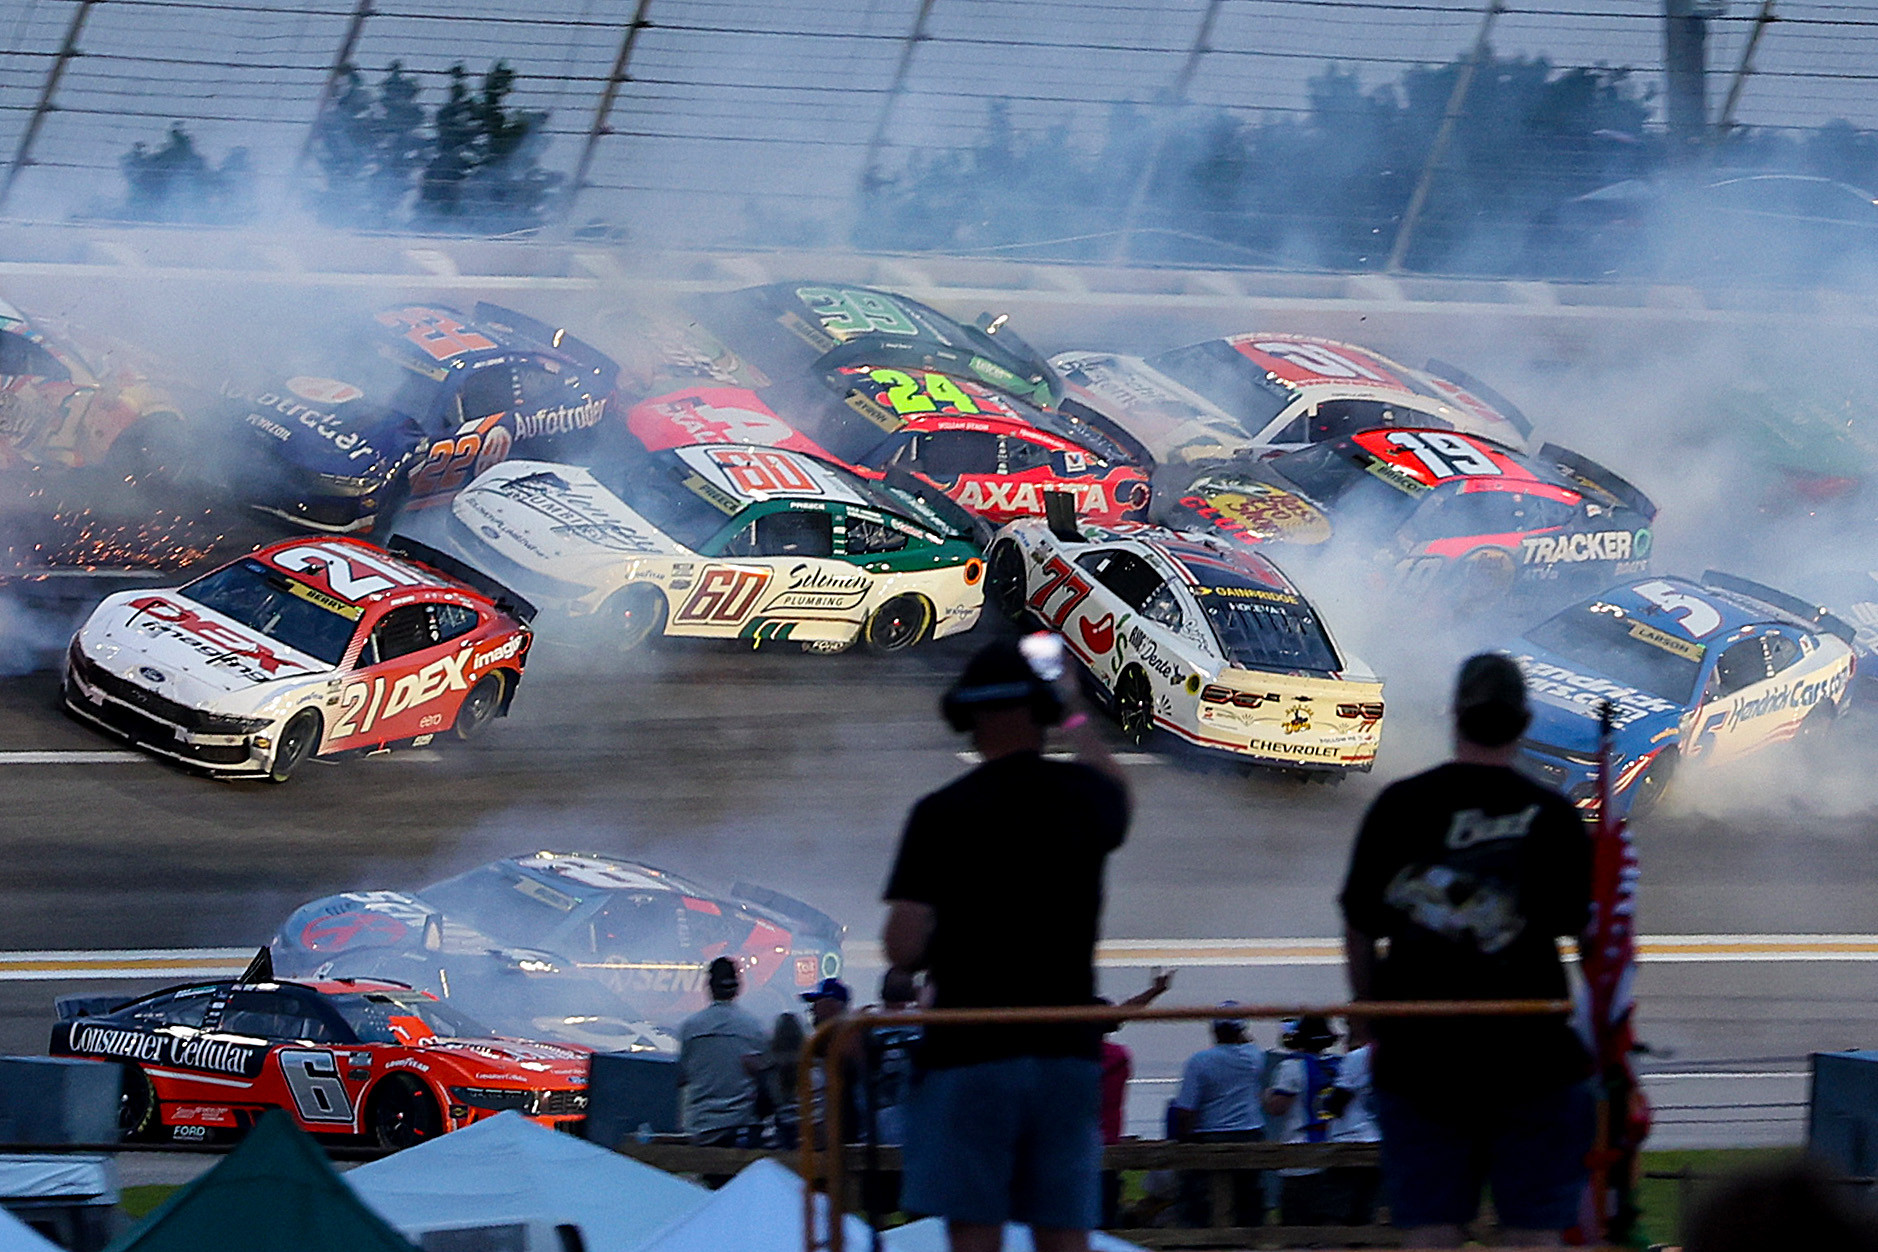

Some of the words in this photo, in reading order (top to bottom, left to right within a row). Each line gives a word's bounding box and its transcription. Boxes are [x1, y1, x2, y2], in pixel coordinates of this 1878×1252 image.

[869, 369, 980, 414] 24
[514, 397, 608, 442] Autotrader
[410, 434, 482, 496] 22
[713, 450, 816, 493] 60
[1386, 431, 1503, 478] 19
[1179, 496, 1264, 545] CLUB
[1522, 530, 1633, 565] TRACKER
[272, 540, 420, 602] 21
[1029, 554, 1094, 631] 77
[306, 588, 347, 611] BERRY
[676, 570, 770, 622] 60
[784, 596, 844, 607] PLUMBING
[1632, 580, 1723, 639] 5
[126, 597, 311, 675] DEX
[1638, 628, 1690, 654] LARSON
[1140, 640, 1173, 679] Dente
[381, 647, 475, 720] DEX
[328, 677, 386, 741] 21
[419, 713, 442, 728] eero
[1249, 738, 1341, 758] CHEVROLET
[69, 1021, 169, 1062] Consumer
[170, 1034, 253, 1075] Cellular
[385, 1057, 430, 1073] GOODYEAR
[279, 1050, 354, 1121] 6
[174, 1126, 205, 1136] FORD
